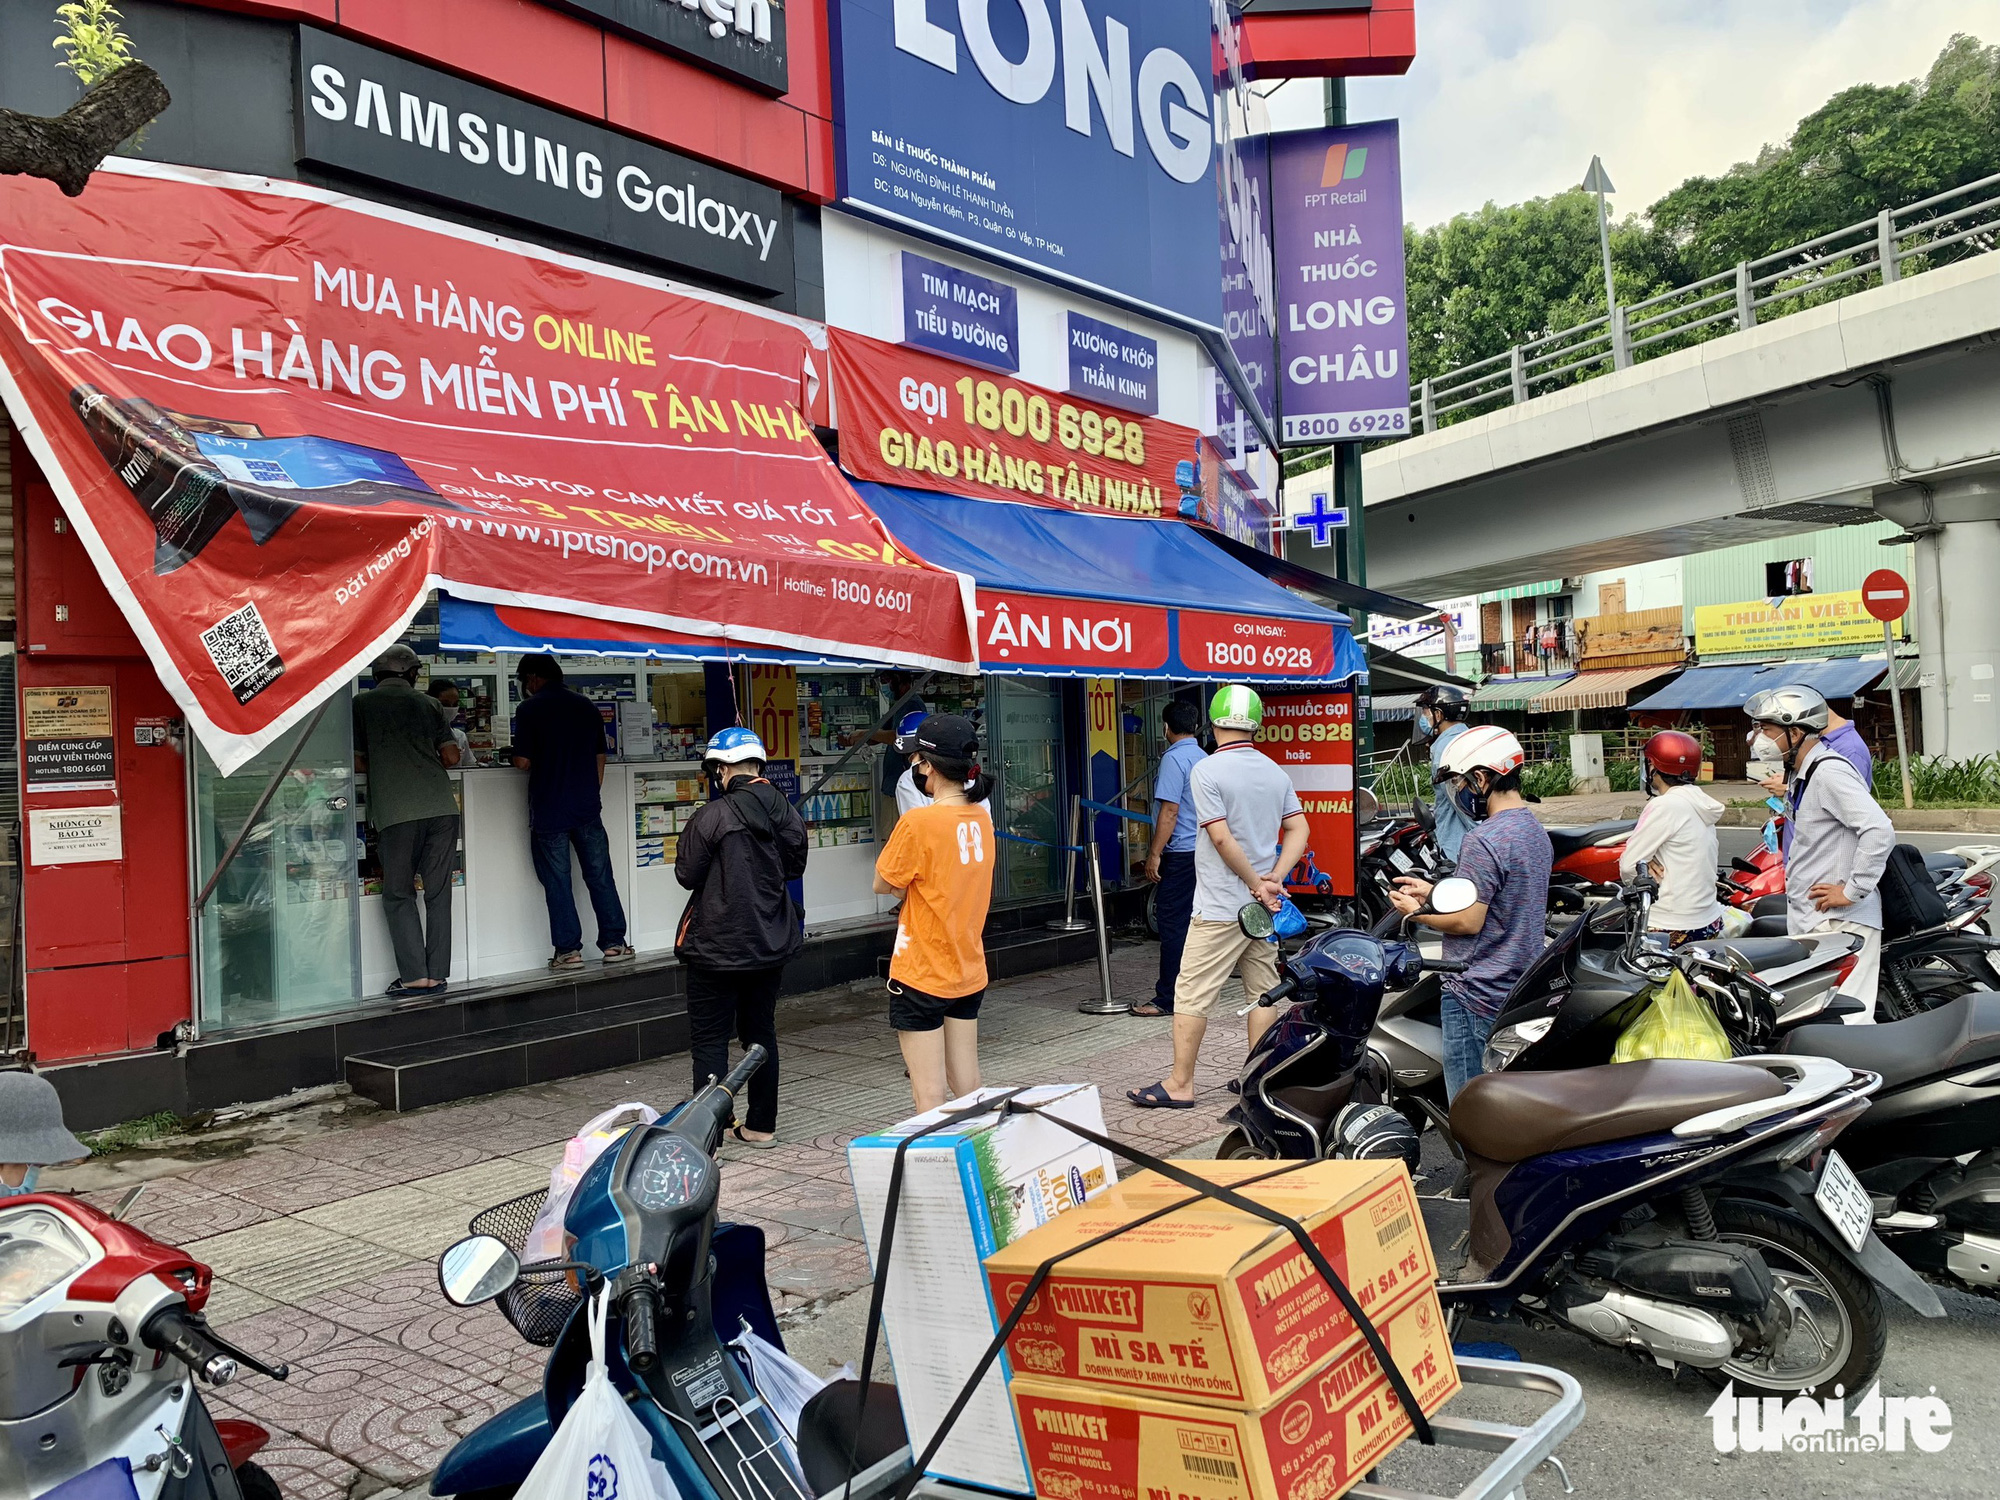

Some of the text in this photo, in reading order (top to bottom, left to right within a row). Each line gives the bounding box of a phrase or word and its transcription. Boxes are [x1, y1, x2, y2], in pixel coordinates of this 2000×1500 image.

[310, 63, 778, 261] SAMSUNG Galaxy
[871, 130, 996, 191] BÁN LẺ THUỐC THÀNH PHẨM
[873, 152, 989, 209] DS: ĐÌNH LÊ THANH
[874, 178, 891, 194] ĐC:
[893, 185, 909, 200] 804
[968, 212, 982, 227] P3,
[983, 218, 1003, 234] Quận
[1005, 227, 1016, 239] Gò
[1035, 237, 1045, 249] TP
[1305, 189, 1367, 208] FPT Retail
[1314, 224, 1362, 248] NHÀ
[1300, 254, 1378, 282] THUỐC
[922, 273, 1000, 315] TIM MẠCH
[313, 261, 657, 367] MUA HÀNG ONLINE
[915, 305, 1008, 353] TIỂU ĐƯỜNG
[1289, 296, 1395, 331] LONG
[1072, 328, 1155, 370] XƯƠNG KHỚP
[1288, 344, 1398, 385] CHÂU
[37, 297, 213, 371] GIAO
[231, 318, 407, 400] HÀNG
[419, 345, 542, 419] MIỄN
[548, 377, 628, 426] PHÍ
[632, 382, 730, 442] TẬN
[1082, 364, 1146, 400] THẦN KINH
[900, 376, 1146, 466] GỌI 1800 6928
[1285, 413, 1405, 437] 1800 6928
[120, 448, 151, 489] NITRO
[879, 428, 1162, 518] GIAO HÀNG TẬN NHÀ!
[470, 466, 838, 526] LAPTOP CAM KẾT GIÁ TỐT
[518, 499, 568, 520] 3
[333, 537, 412, 606] Đặt hàng
[784, 576, 912, 613] Hotline: 1800 6601
[1234, 623, 1286, 637] GỌI NGAY:
[1724, 600, 1863, 626] THUẬN VIỆT
[1062, 618, 1132, 652] NƠI
[1206, 642, 1312, 668] 1800 6928
[240, 690, 254, 702] MUA
[1278, 700, 1348, 718] THUỐC GỌI
[37, 742, 59, 751] ĐIỂM
[86, 742, 102, 750] CẤP
[1298, 722, 1353, 742] 6928
[28, 755, 48, 763] DỊCH
[49, 755, 62, 763] VỤ
[84, 752, 112, 760] THÔNG
[1286, 750, 1312, 762] hoặc
[1316, 797, 1353, 813] NHÀ!
[49, 820, 85, 829] KHÔNG
[1274, 1129, 1301, 1137] HONDA
[1038, 1169, 1048, 1196] SỮA
[1072, 1168, 1084, 1203] VINAMIL
[1254, 1242, 1320, 1307] MILIKE
[1357, 1245, 1419, 1309] MÌ SA TẾ
[1053, 1286, 1133, 1316] MILIKET
[1274, 1291, 1330, 1336] INSTANT NOODLES
[1276, 1284, 1322, 1320] SATAY FLAVOUR
[1033, 1322, 1056, 1334] 30 gói
[1308, 1328, 1318, 1342] 65
[1330, 1313, 1339, 1326] 30
[1091, 1333, 1209, 1369] MÌ SA TẾ
[1085, 1363, 1205, 1388] DOANH NGHIỆP XANH VÌ CỘNG
[1322, 1351, 1378, 1410] MILIKE
[1357, 1395, 1382, 1436] MÌ
[1412, 1344, 1437, 1386] TẾ
[1033, 1408, 1108, 1442] MILIKET
[1048, 1452, 1111, 1472] INSTANT NOODLES
[1051, 1442, 1103, 1460] SATAY FLAVOUR
[1281, 1465, 1292, 1476] 65
[1305, 1445, 1315, 1458] 30
[1315, 1431, 1333, 1449] bags
[1353, 1425, 1391, 1464] COMMUNITY
[1084, 1479, 1095, 1490] 65
[1096, 1483, 1102, 1493] g
[1110, 1484, 1120, 1495] 30
[1121, 1487, 1135, 1499] gói
